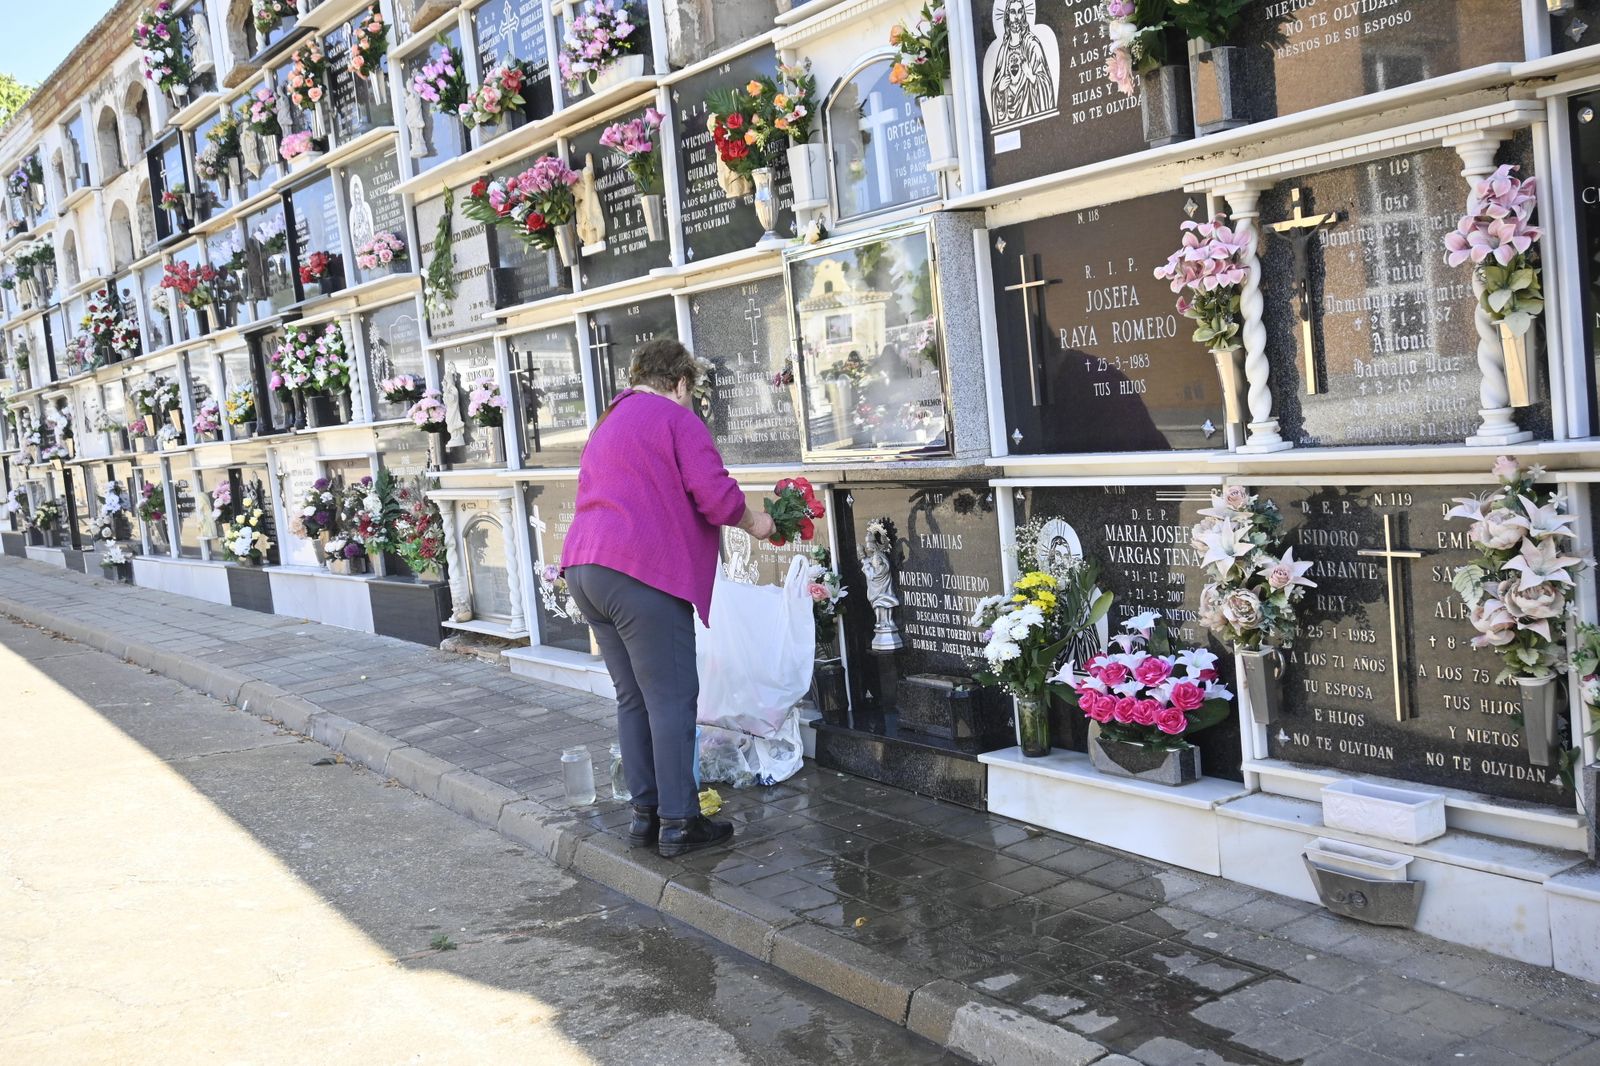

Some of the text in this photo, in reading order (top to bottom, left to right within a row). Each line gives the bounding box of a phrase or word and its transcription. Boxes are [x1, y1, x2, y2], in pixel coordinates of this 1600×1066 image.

[1285, 20, 1303, 37] NO
[1309, 11, 1328, 29] TE
[1277, 10, 1412, 59] RESTOS DE SU ESPOSO
[1070, 48, 1099, 68] A LOS
[1079, 69, 1092, 84] TU
[1072, 82, 1113, 106] HIJAS Y
[1072, 94, 1142, 125] NO TE OLVIDA
[886, 116, 923, 142] ORTEGA
[686, 130, 713, 149] VICTORI
[690, 148, 706, 165] RUIZ
[687, 161, 717, 181] GUIRADO
[1390, 158, 1410, 176] 119
[903, 173, 928, 189] PRIMAS
[682, 200, 687, 210] A
[687, 197, 699, 208] LOS
[708, 188, 725, 201] AÑOS
[691, 208, 708, 220] HIJOS
[709, 206, 713, 216] Y
[714, 199, 736, 214] NIETOS
[1088, 211, 1100, 222] 118
[685, 214, 730, 236] NO TE OLVIDAN
[1085, 258, 1138, 279] R. I. P.
[1085, 285, 1140, 313] JOSEFA
[1059, 314, 1177, 349] RAYA ROMERO
[1093, 379, 1147, 397] TUS HIJOS
[1131, 508, 1169, 521] D. E. P.
[1301, 501, 1352, 515] D. E. P.
[920, 533, 963, 550] FAMILIAS
[1104, 524, 1190, 543] MARIA JOSEF
[1298, 528, 1359, 547] ISIDORO
[1107, 545, 1201, 567] VARGAS TENA
[899, 570, 990, 592] MORENO IZQUIERDO
[943, 594, 980, 612] MARTIN
[1119, 604, 1197, 622] TUS NIETOS
[1317, 594, 1347, 612] REY
[916, 610, 972, 627] DESCANSEN EN PA
[920, 624, 936, 636] YACE
[937, 627, 945, 638] UN
[946, 628, 972, 641] TORERO
[972, 631, 977, 643] Y
[1168, 626, 1181, 639] NO
[1183, 628, 1194, 641] TE
[1290, 651, 1386, 672] A LOS 71 AÑOS
[1418, 664, 1427, 677] A
[1437, 665, 1462, 680] LOS
[1472, 668, 1489, 683] 75
[1304, 680, 1373, 700] TU ESPOSA
[1443, 694, 1521, 715] TUS HIJOS
[1314, 708, 1365, 727] E HIJOS
[1293, 732, 1394, 760] NO TE OLVIDAN
[1448, 725, 1520, 748] Y NIETOS
[1426, 751, 1546, 783] NO TE OLVIDAN
